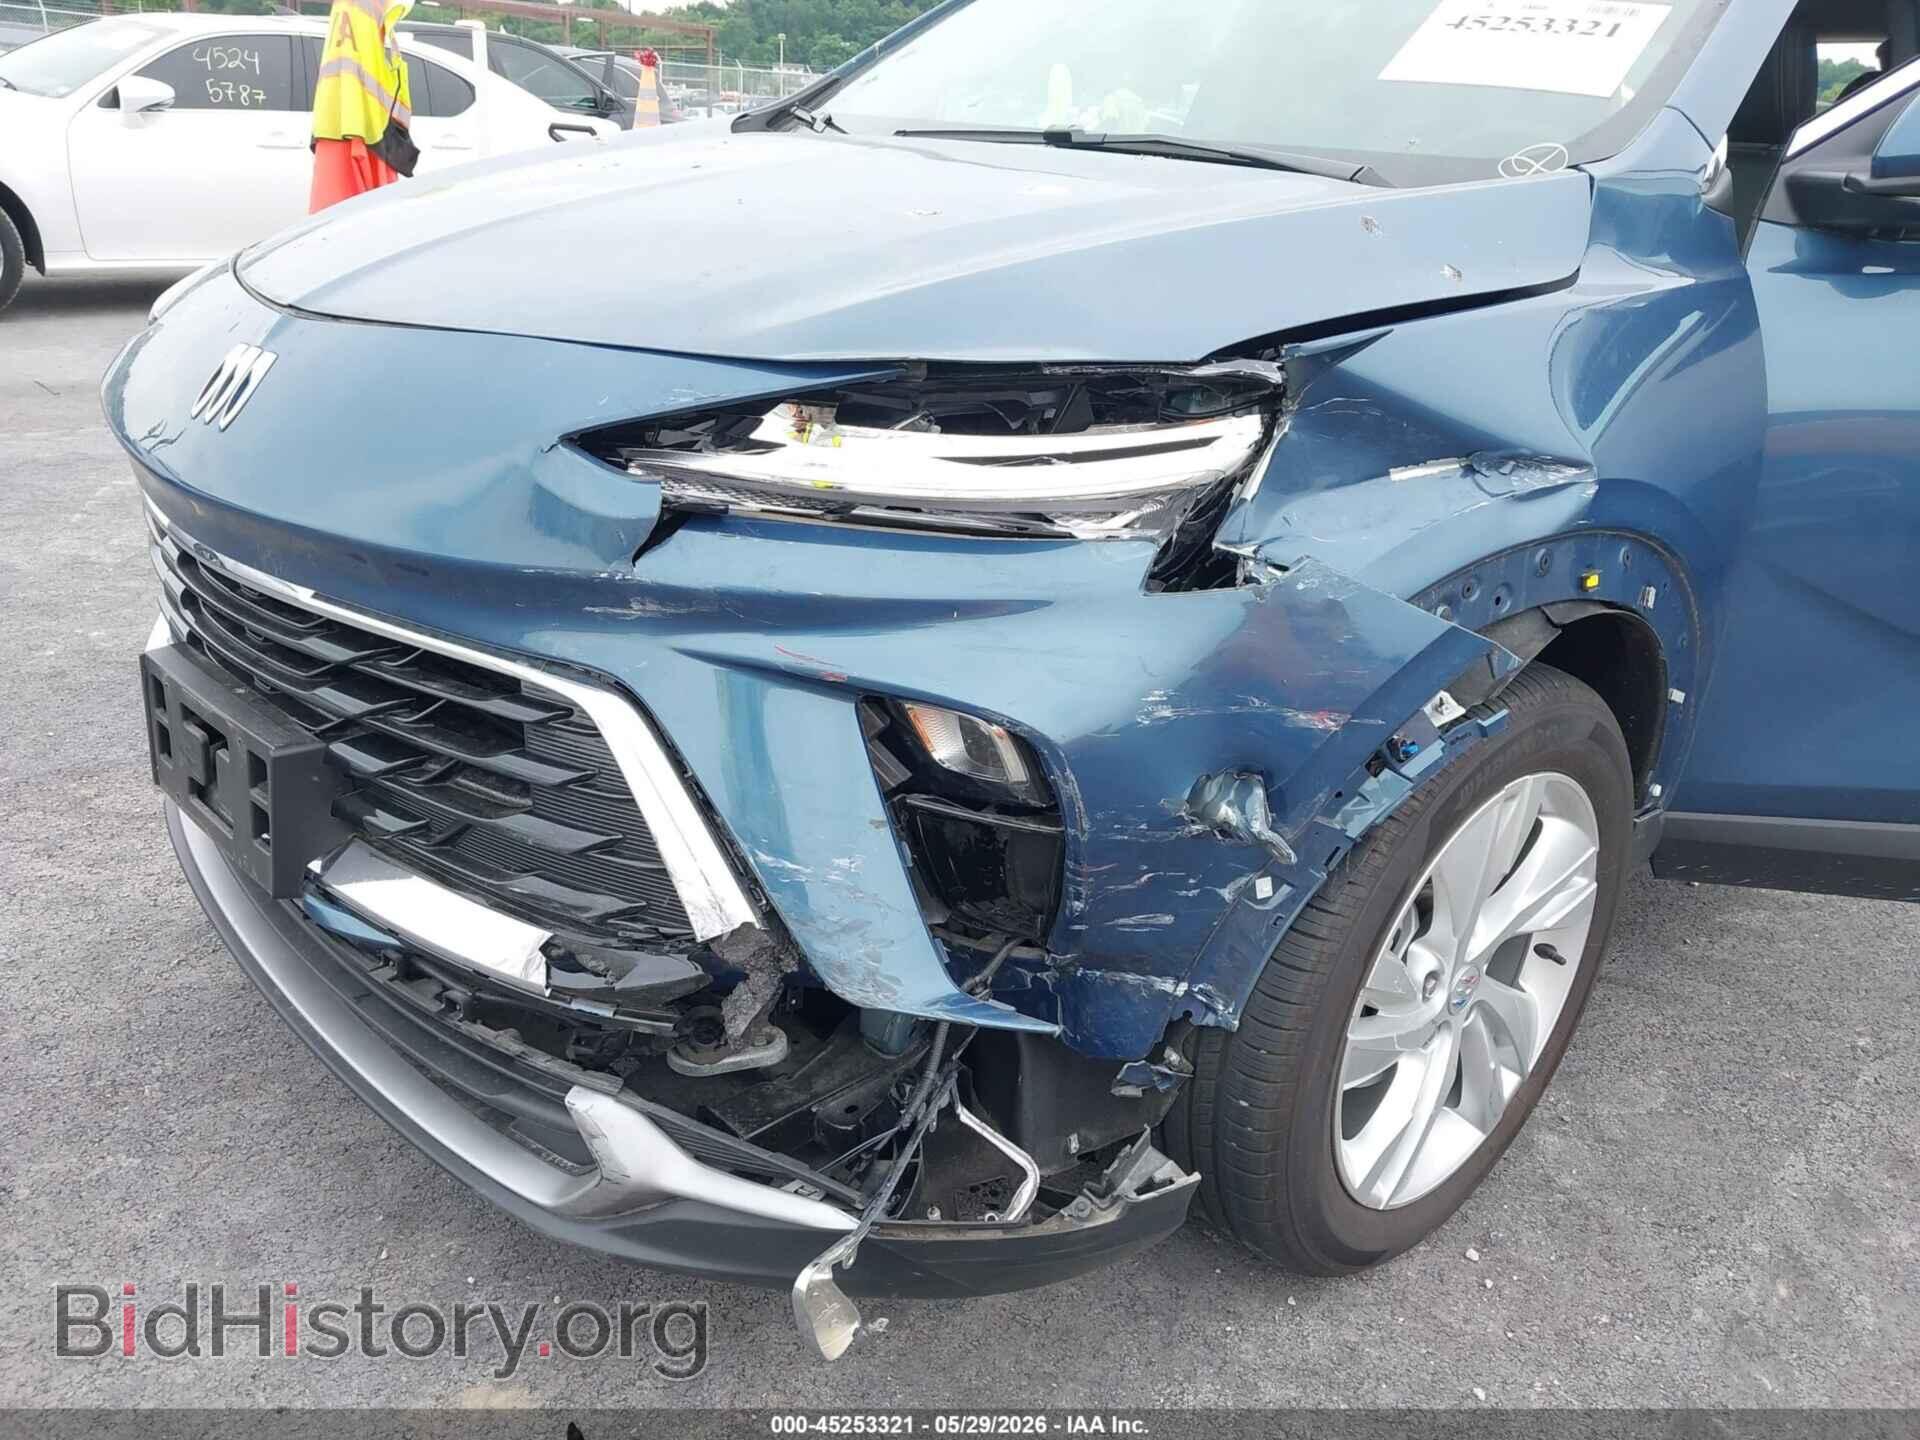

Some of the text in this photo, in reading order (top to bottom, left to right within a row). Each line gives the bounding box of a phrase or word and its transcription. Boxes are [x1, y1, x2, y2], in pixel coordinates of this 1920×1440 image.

[1446, 15, 1621, 37] 45253321
[193, 47, 260, 75] 4524
[206, 78, 267, 106] 5787
